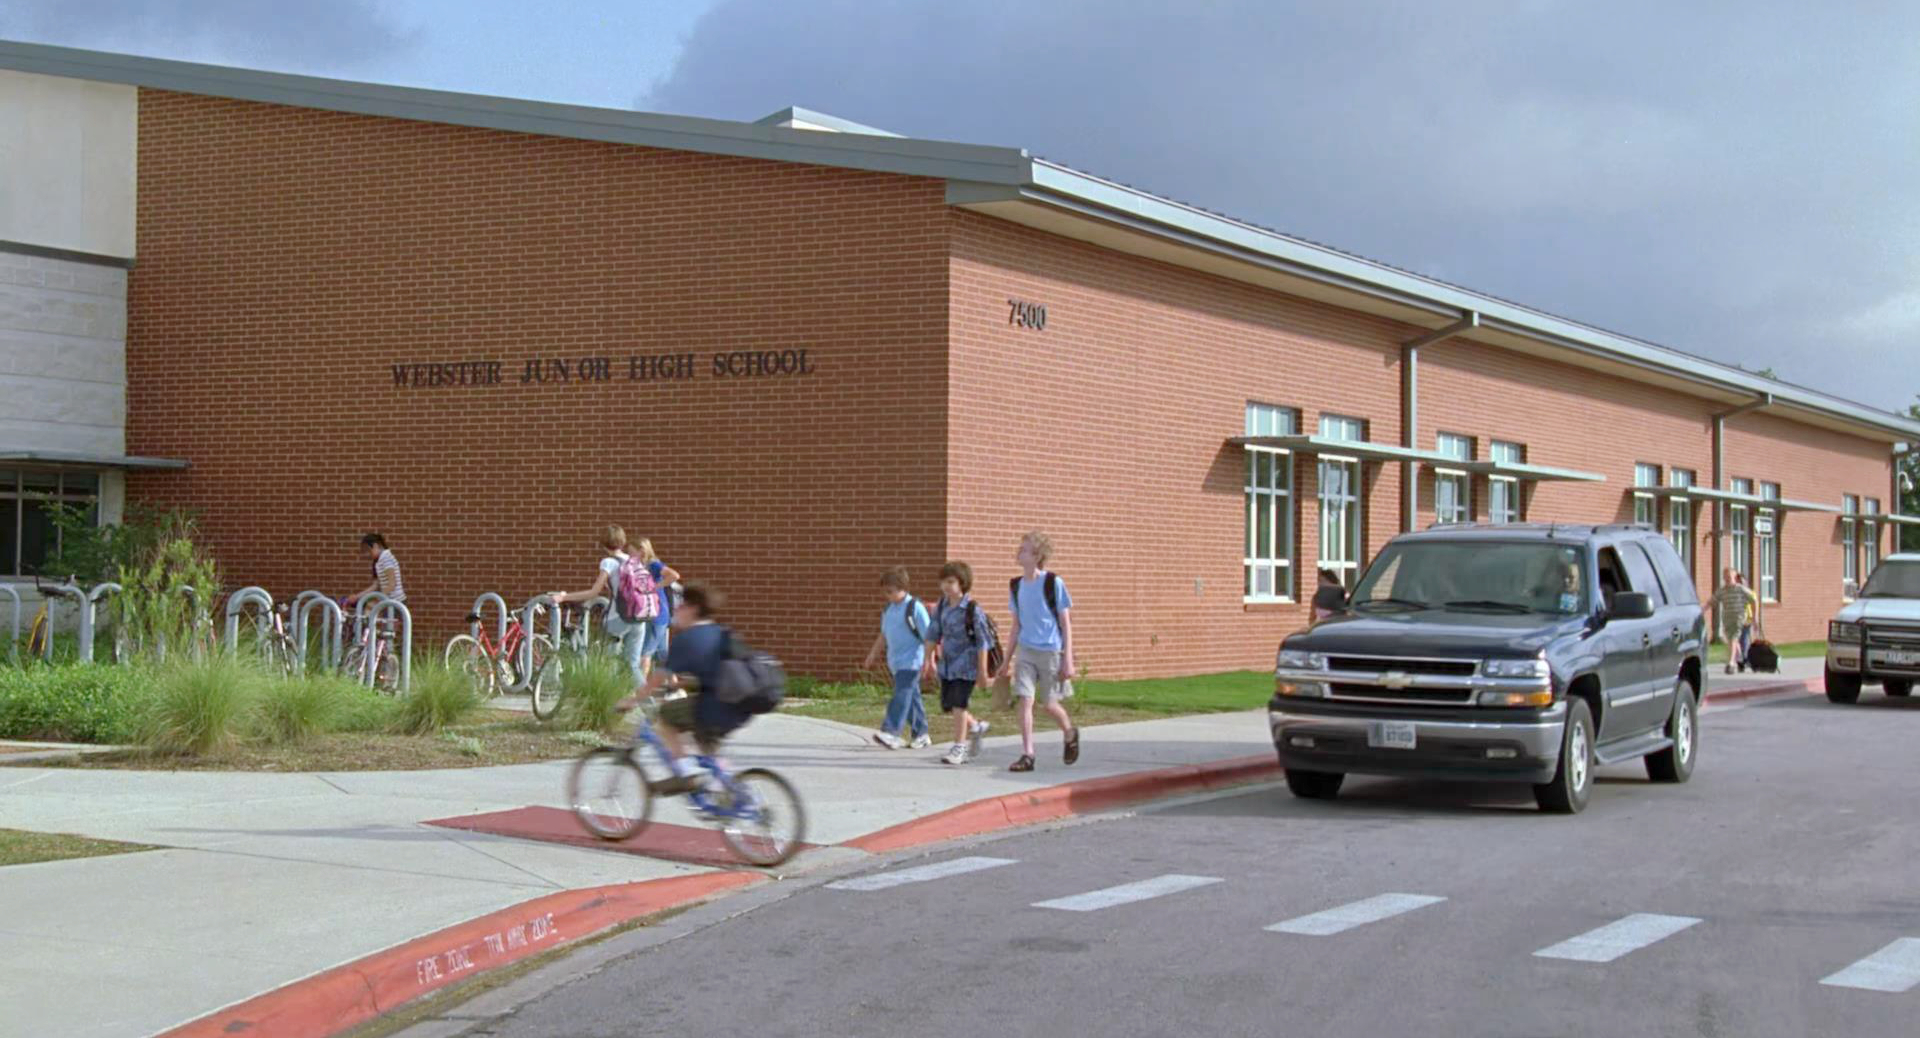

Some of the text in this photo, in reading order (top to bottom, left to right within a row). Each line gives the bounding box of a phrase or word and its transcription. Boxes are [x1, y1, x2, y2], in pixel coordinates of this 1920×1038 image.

[1008, 299, 1047, 330] 7500
[391, 361, 501, 387] WEBSTER
[629, 352, 695, 380] HIGH
[712, 348, 815, 377] SCHOOL
